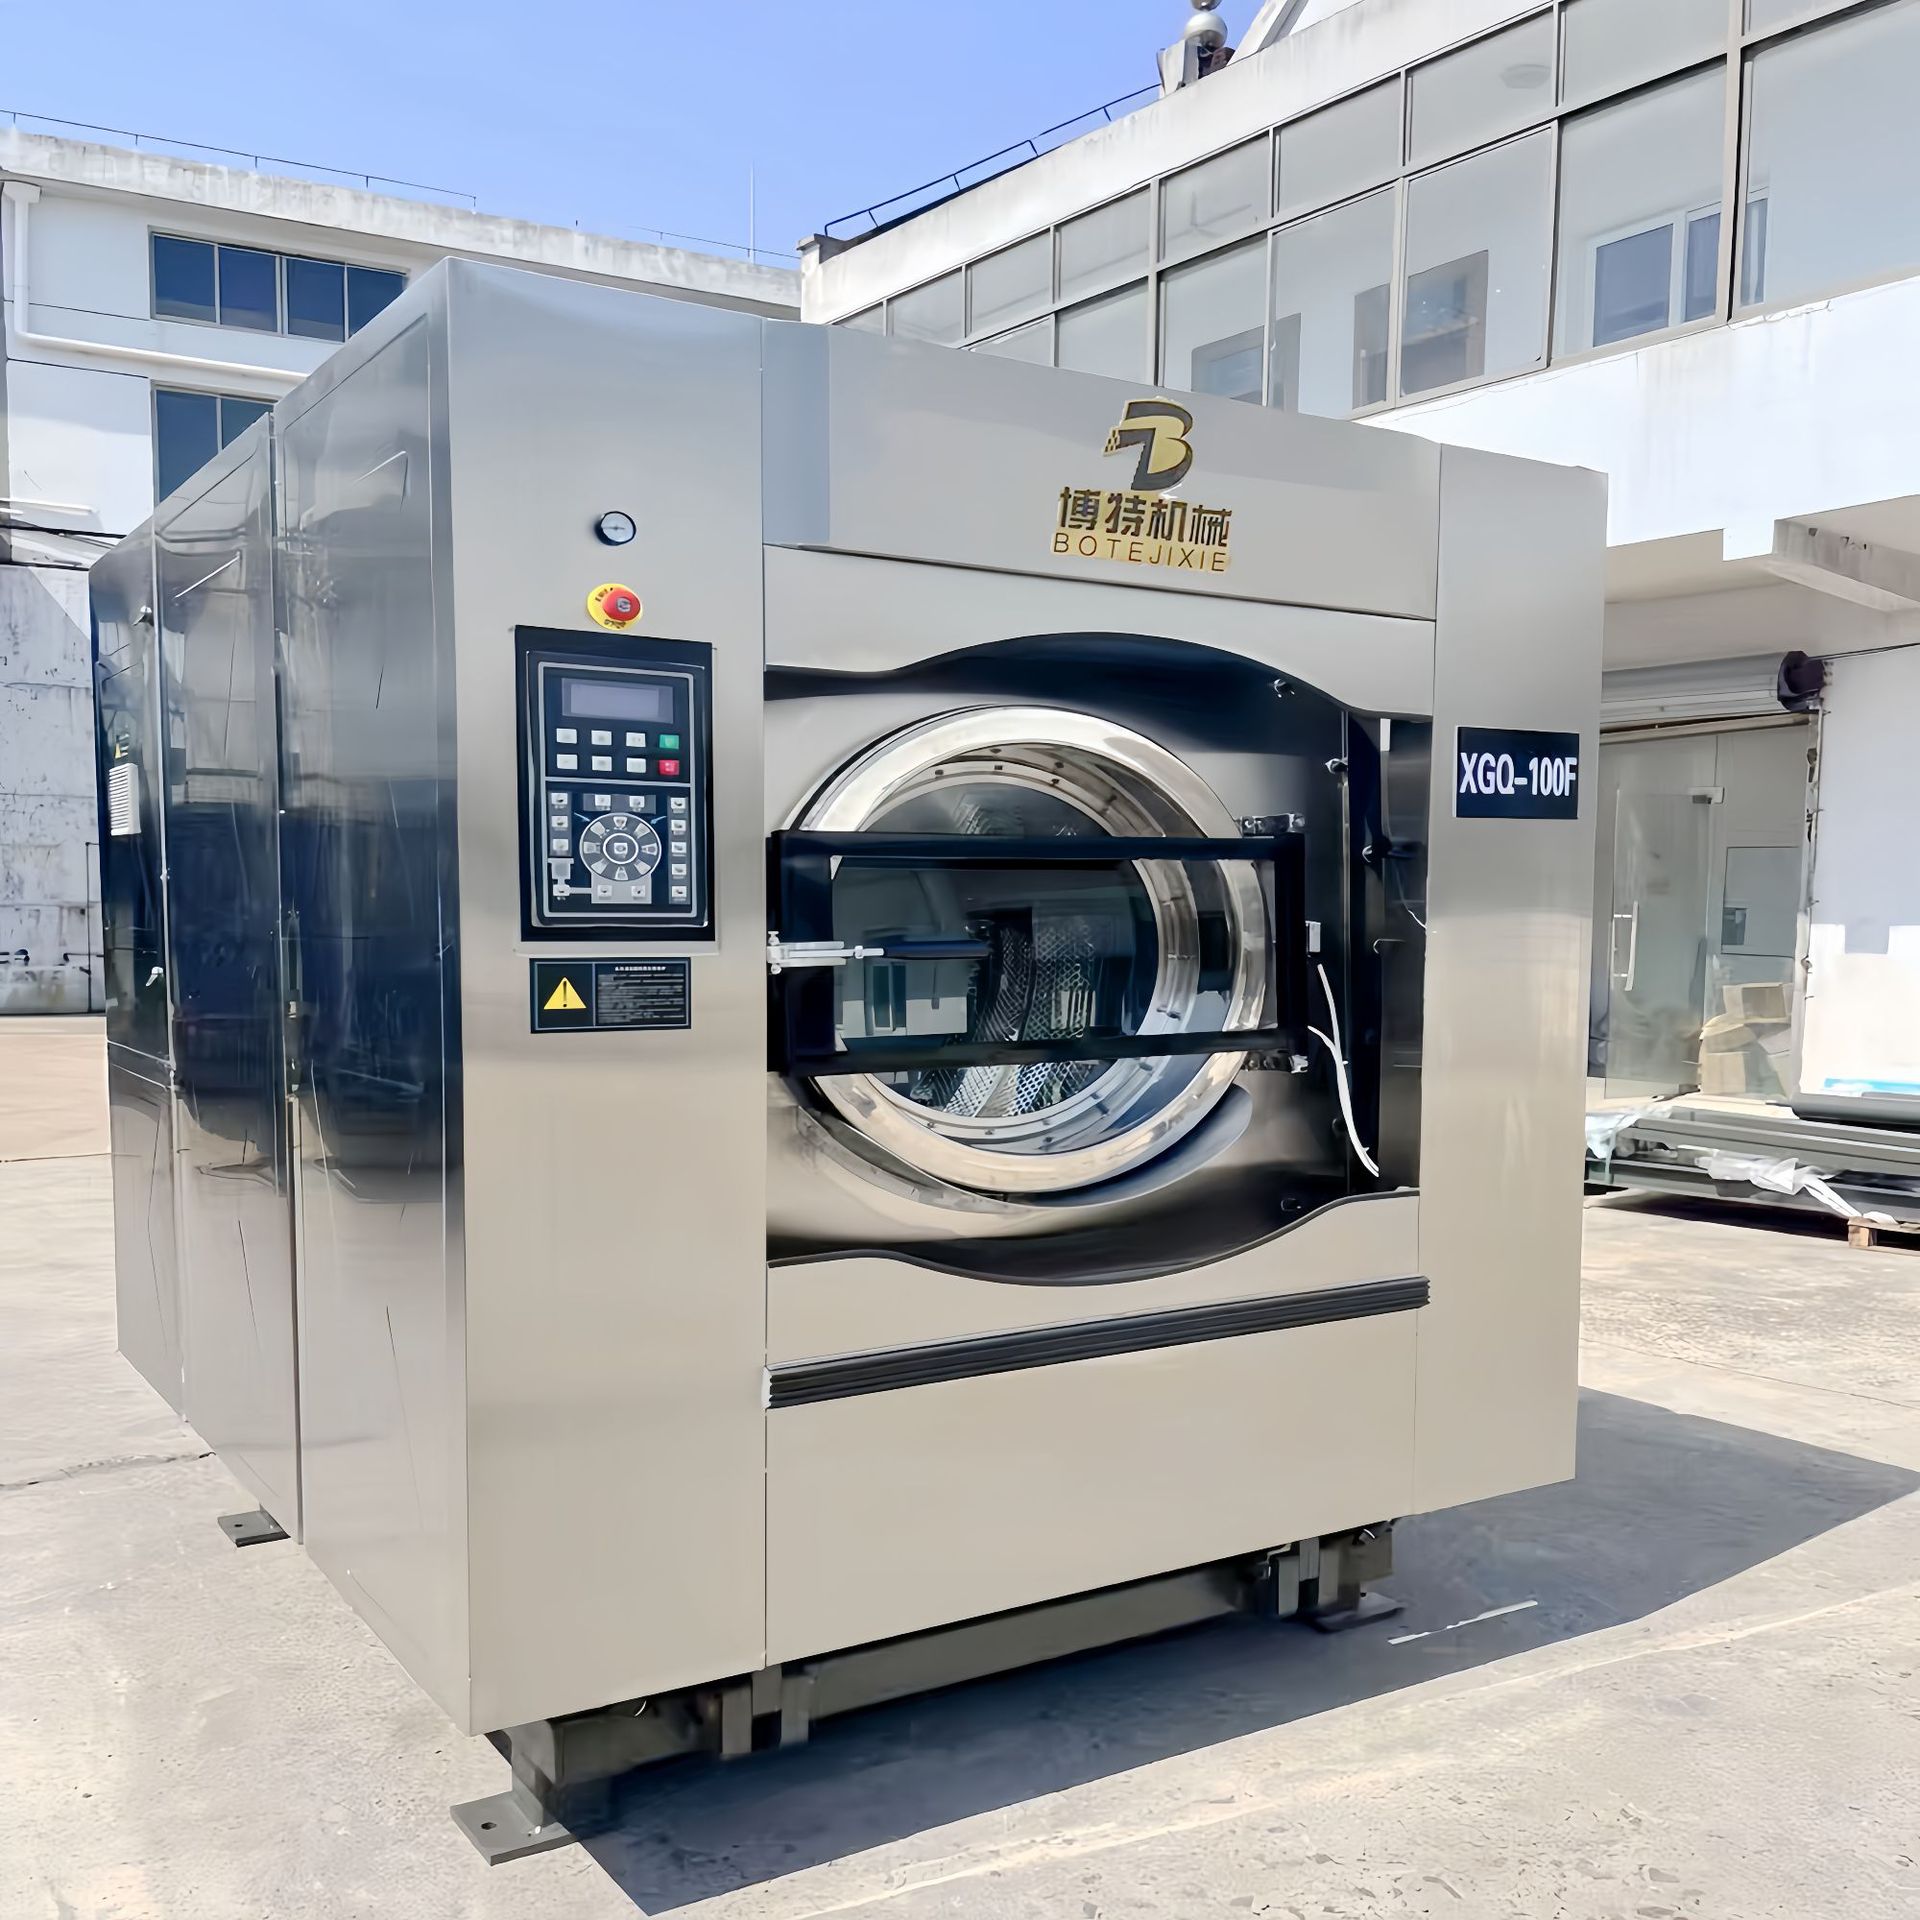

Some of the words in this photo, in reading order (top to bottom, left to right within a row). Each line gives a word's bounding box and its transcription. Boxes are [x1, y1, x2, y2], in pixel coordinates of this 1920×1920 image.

[1058, 486, 1232, 547] 博特机械
[1054, 532, 1226, 572] BOTEJIXIE
[1459, 752, 1577, 797] XGQ-100F
